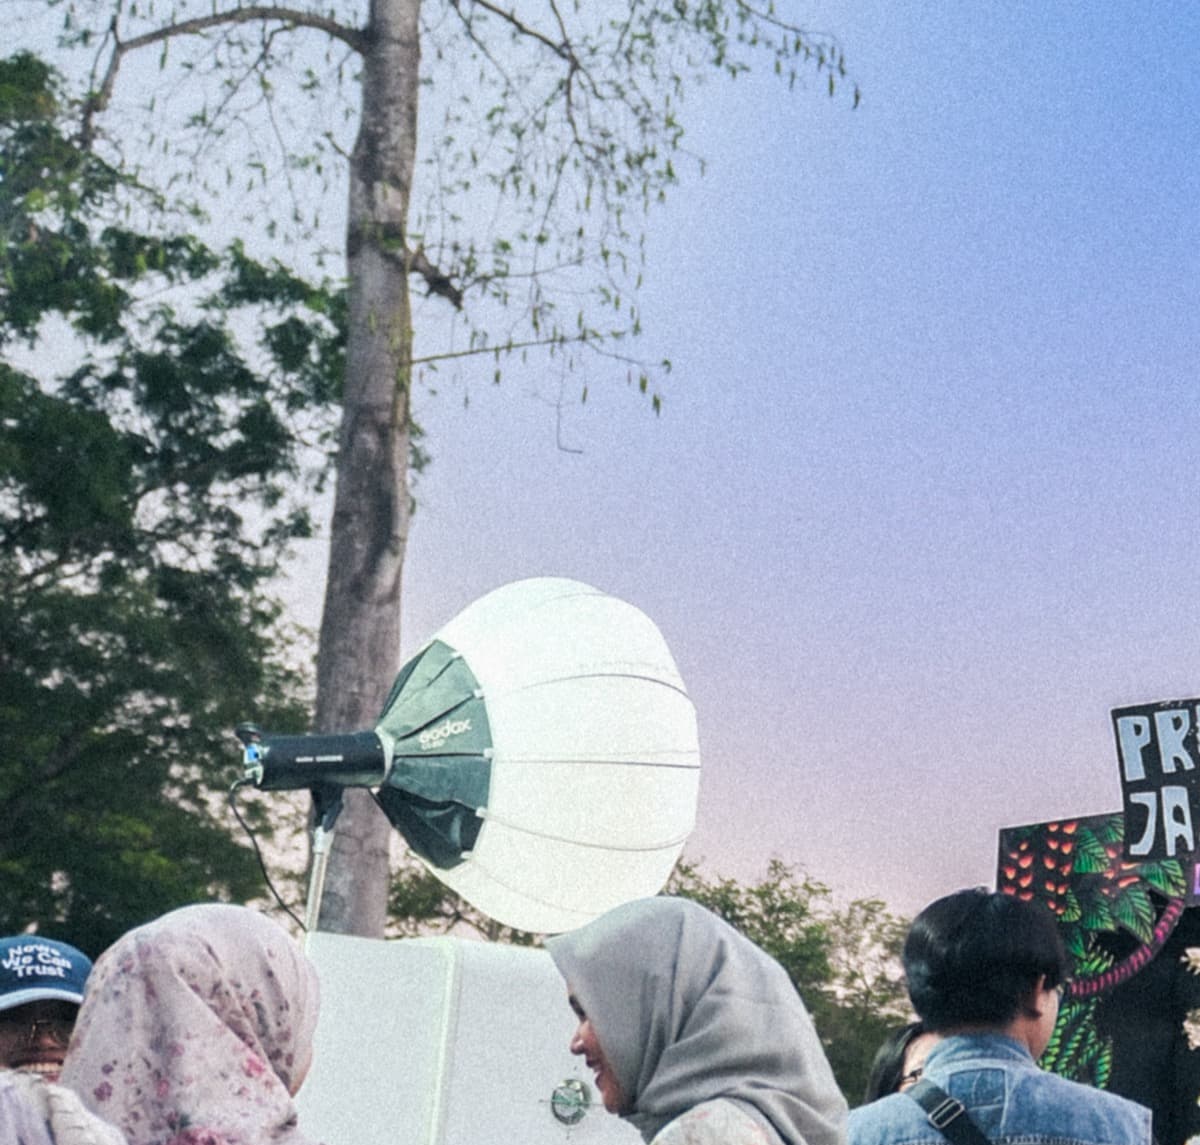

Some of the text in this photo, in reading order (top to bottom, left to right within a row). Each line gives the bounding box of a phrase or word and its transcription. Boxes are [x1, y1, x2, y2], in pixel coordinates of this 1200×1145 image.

[2, 952, 72, 969] We Can
[12, 964, 65, 978] Trust
